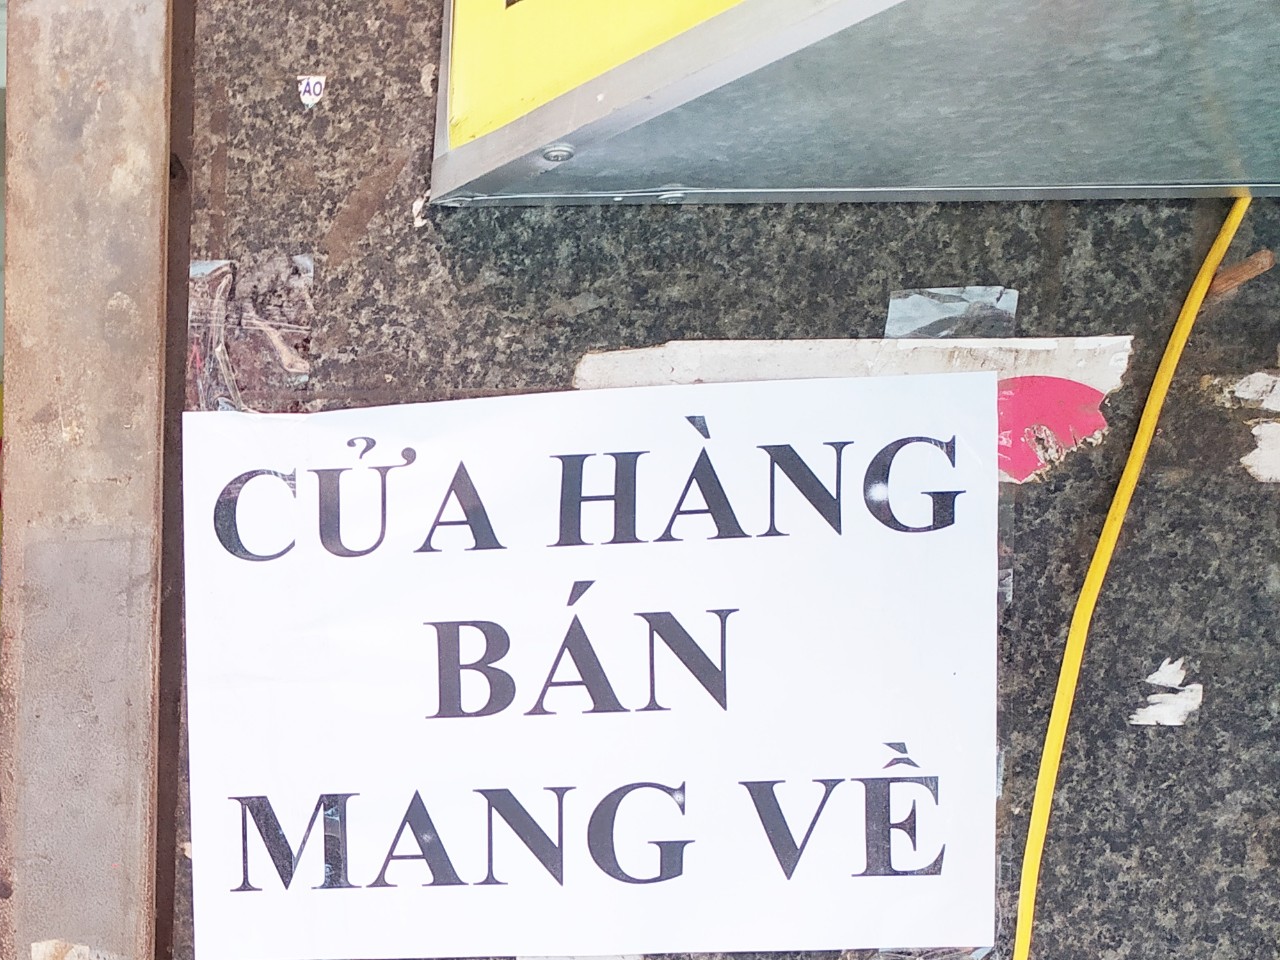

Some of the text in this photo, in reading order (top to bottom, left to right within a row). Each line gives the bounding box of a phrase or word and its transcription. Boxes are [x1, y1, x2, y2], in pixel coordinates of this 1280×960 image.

[213, 415, 967, 562] CỬA HÀNG
[424, 580, 740, 719] BÁN
[228, 742, 946, 892] MANG VỀ
